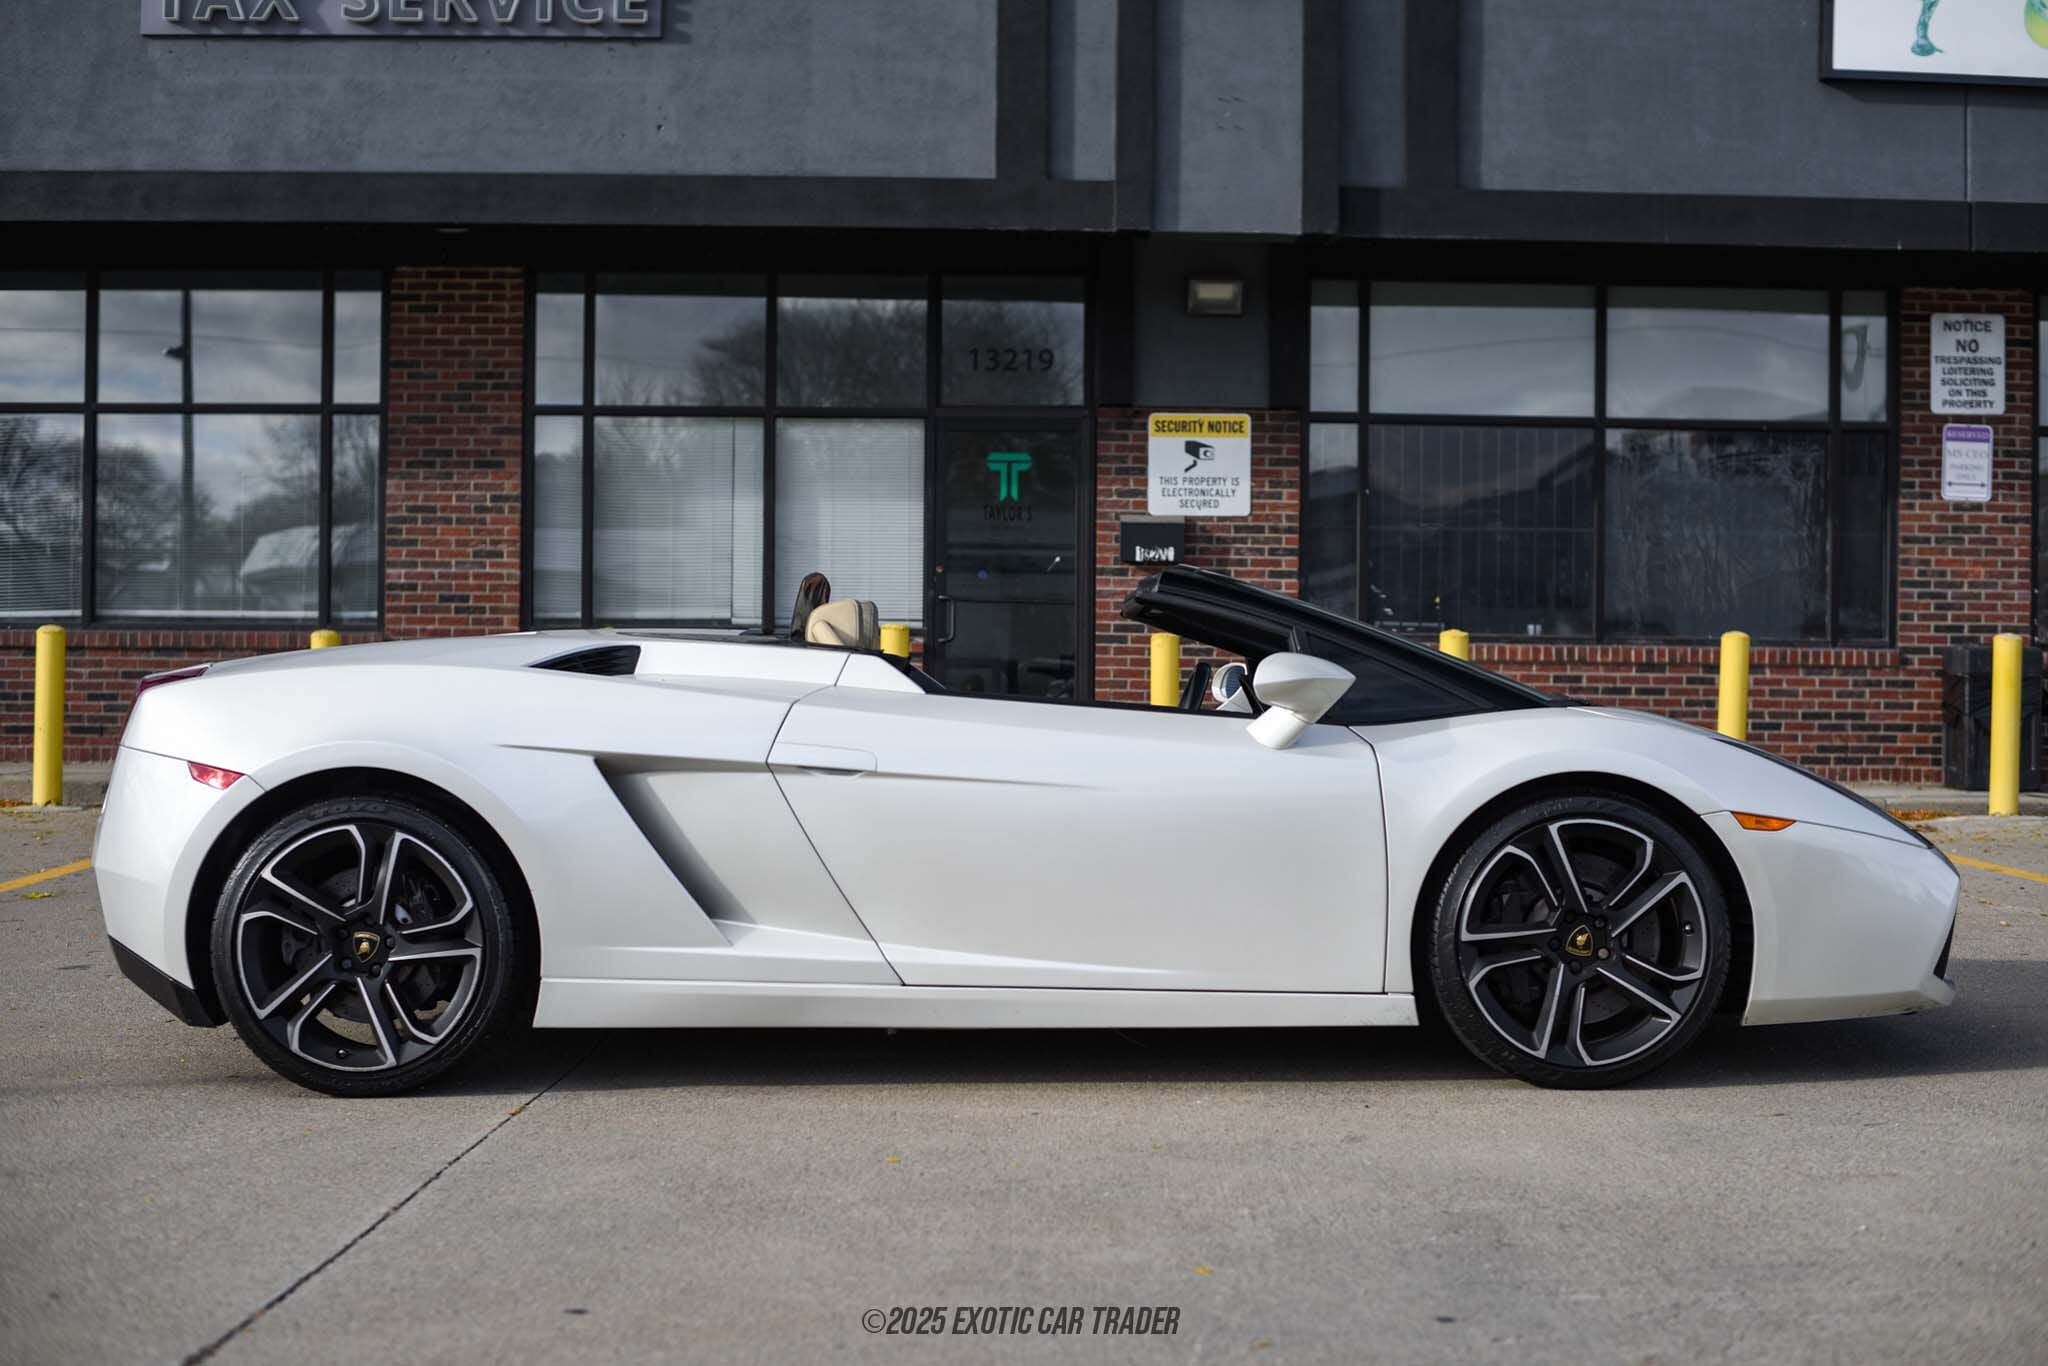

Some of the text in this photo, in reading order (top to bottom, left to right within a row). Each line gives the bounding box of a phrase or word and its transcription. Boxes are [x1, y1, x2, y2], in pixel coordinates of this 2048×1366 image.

[1942, 320, 1993, 333] NOTICE
[1955, 339, 1980, 353] NO
[968, 348, 1055, 372] 13219
[1934, 355, 2002, 366] TRESPASSING
[1942, 367, 1995, 377] LOITERING
[1940, 378, 1996, 388] SOLICITING
[1948, 389, 1988, 398] ON THIS
[1941, 400, 1995, 410] PROPERTY
[1154, 420, 1246, 433] SECURITY NOTICE
[1159, 476, 1241, 487] THIS PROPERTY IS
[1161, 488, 1237, 498] ELECTRONICALLY
[1178, 499, 1220, 510] SECURED
